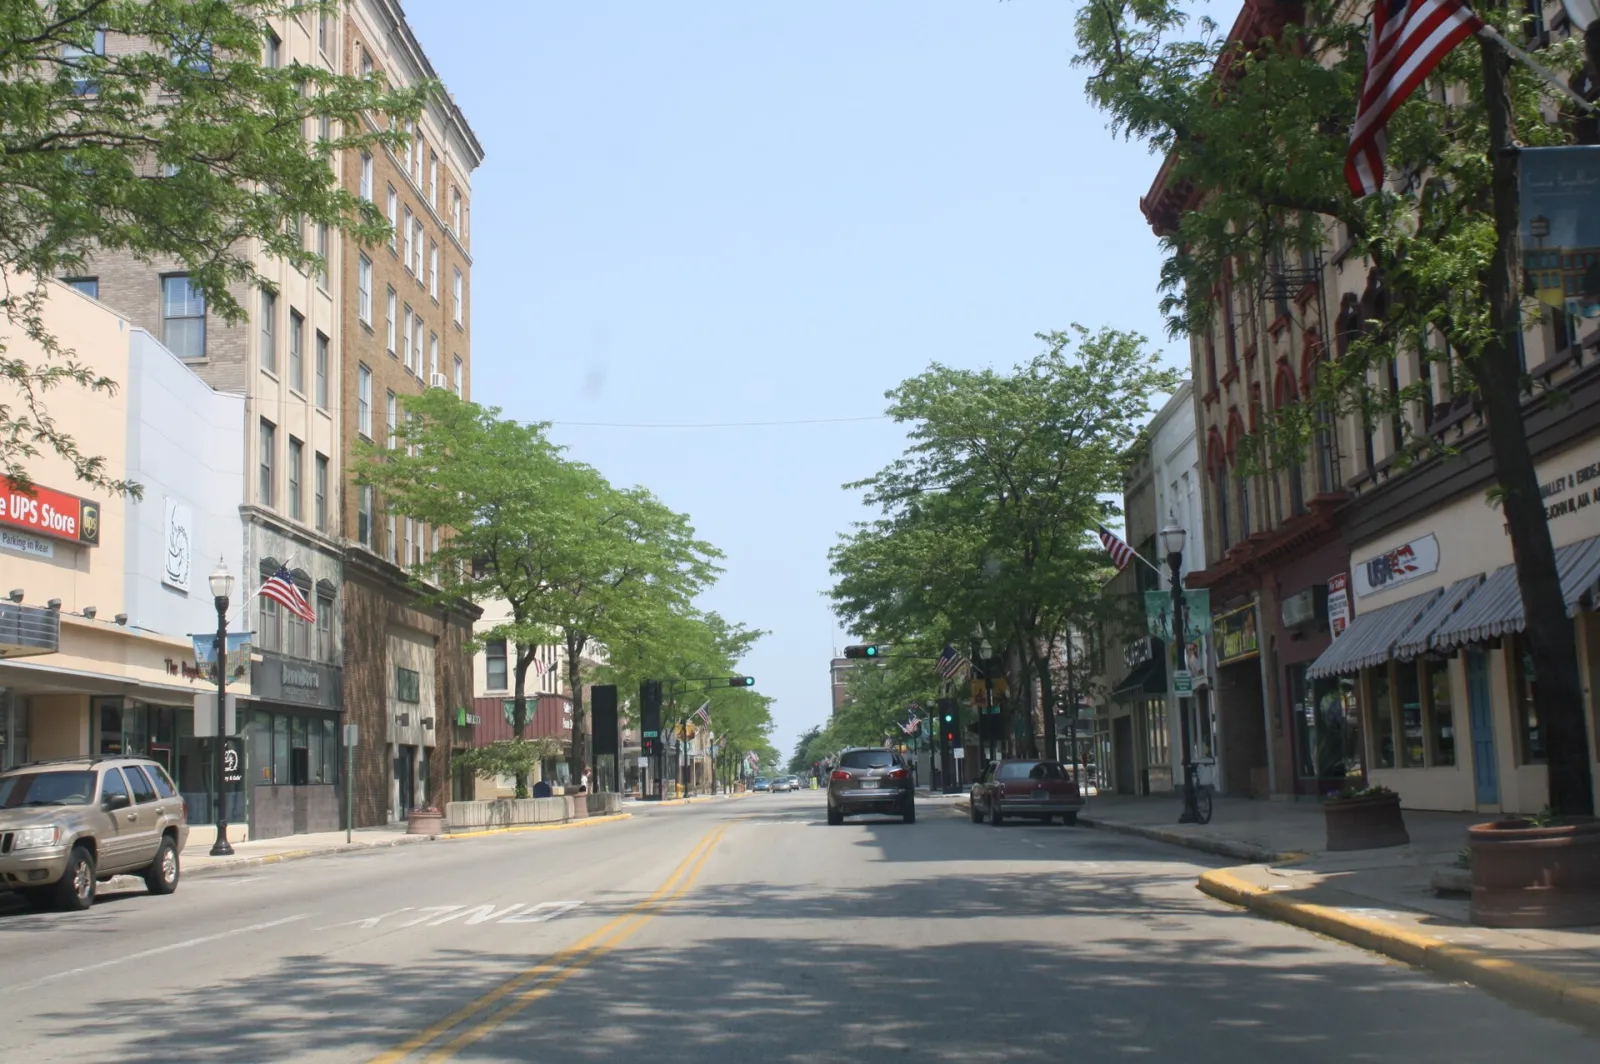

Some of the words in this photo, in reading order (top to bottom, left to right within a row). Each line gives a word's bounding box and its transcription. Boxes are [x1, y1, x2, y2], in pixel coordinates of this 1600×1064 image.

[10, 493, 38, 524] UPS
[41, 503, 75, 534] Store
[2, 532, 26, 551] Parking
[27, 539, 34, 549] in
[34, 540, 48, 553] Rear
